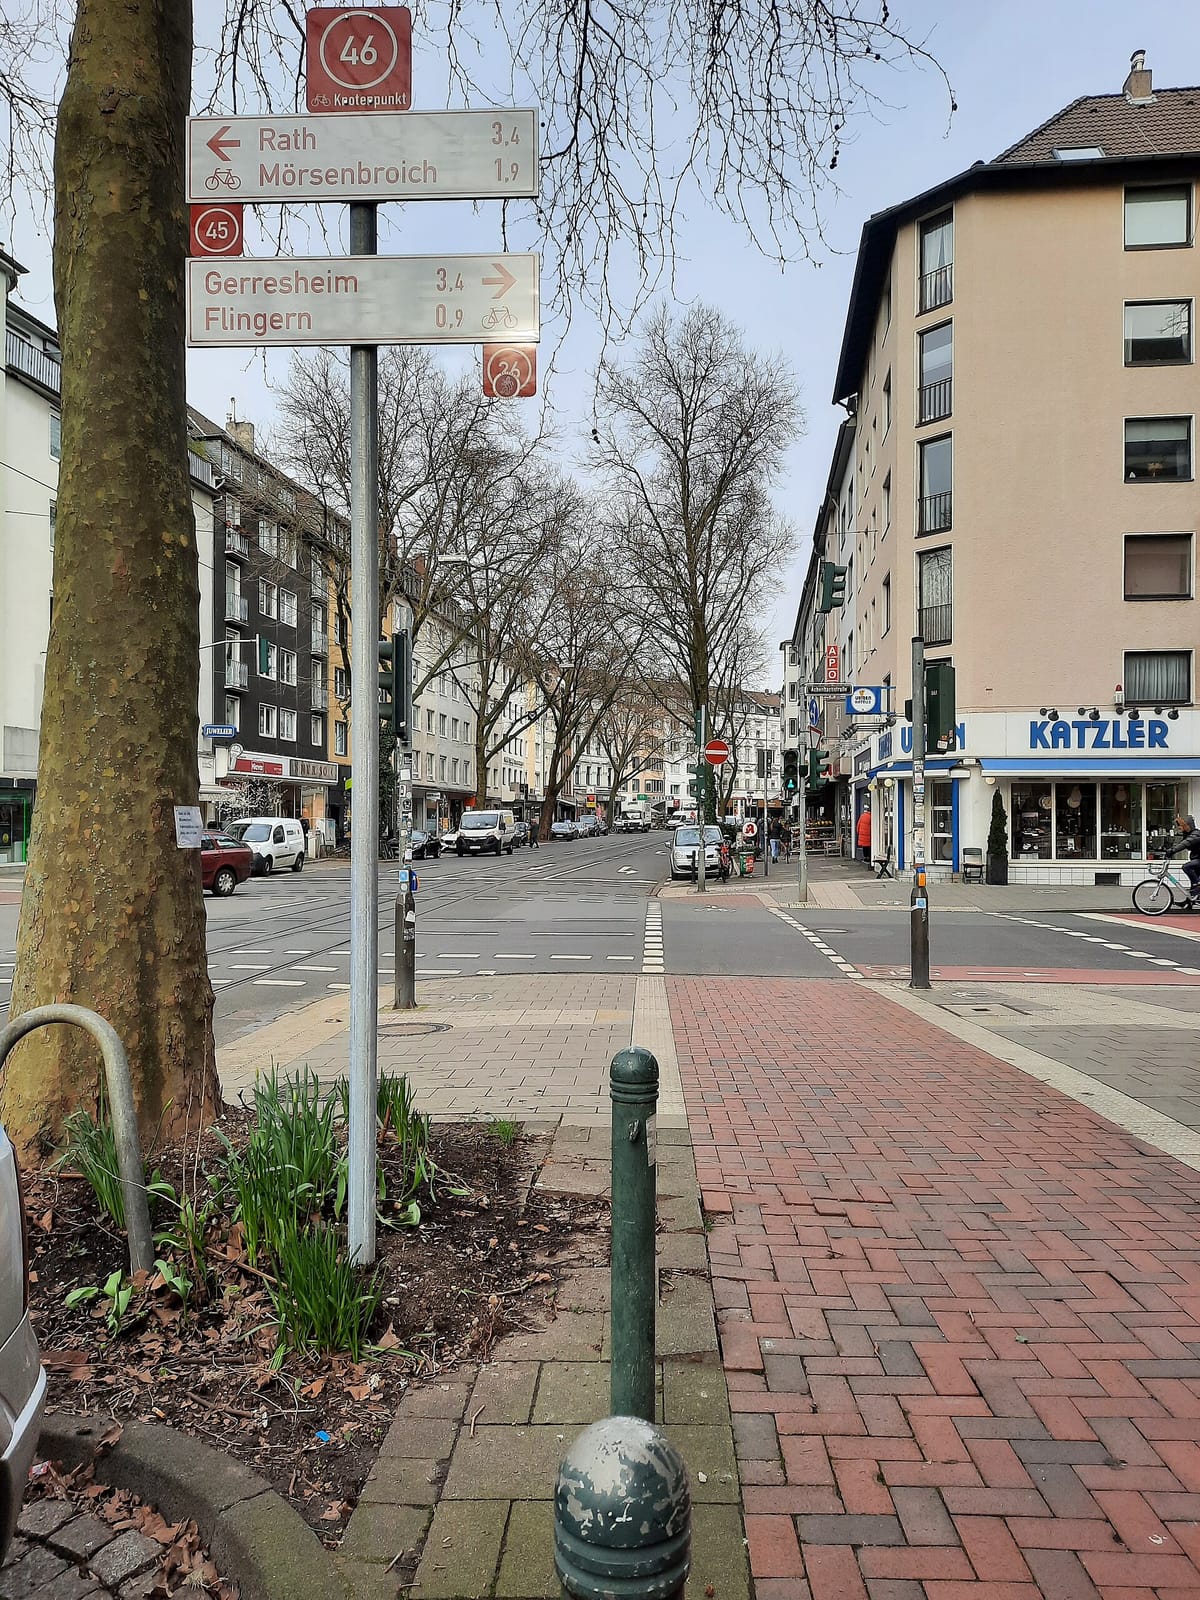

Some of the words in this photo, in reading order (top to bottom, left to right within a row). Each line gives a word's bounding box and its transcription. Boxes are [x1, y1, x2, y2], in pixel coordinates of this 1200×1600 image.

[339, 35, 378, 65] 46
[258, 127, 317, 151] Rath
[490, 121, 521, 146] 3,4
[257, 160, 438, 187] Mörsenbroich
[493, 158, 520, 183] 1,9
[205, 221, 229, 240] 45
[204, 269, 359, 295] Gerresheim
[435, 267, 465, 292] 3,4
[204, 306, 313, 337] Flingern
[434, 303, 465, 328] 0,9
[498, 360, 521, 378] 26
[1029, 719, 1170, 749] KATZLER
